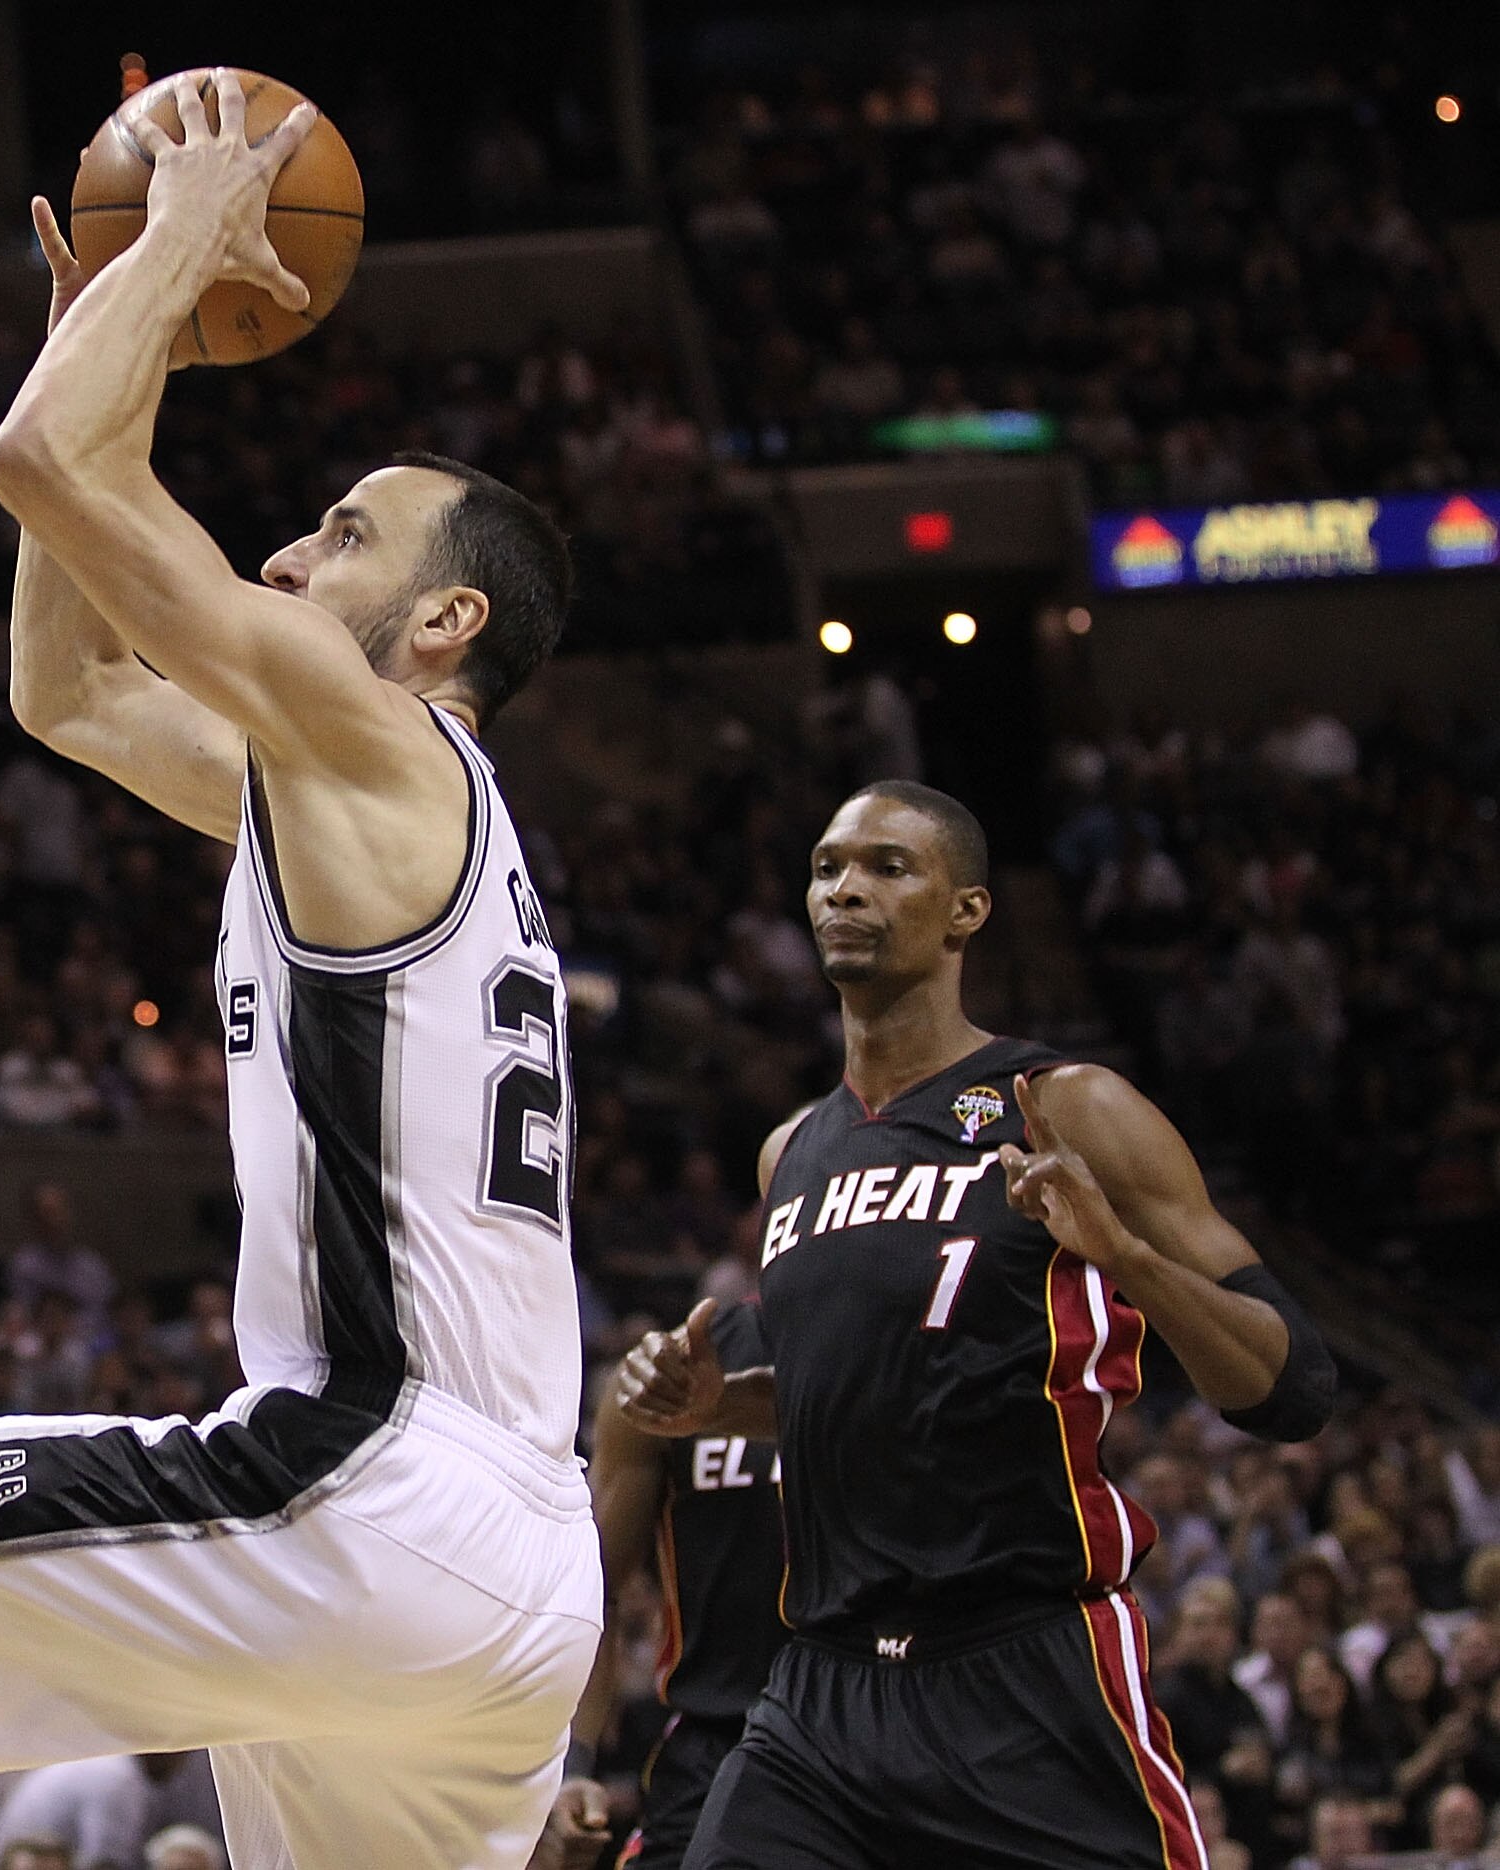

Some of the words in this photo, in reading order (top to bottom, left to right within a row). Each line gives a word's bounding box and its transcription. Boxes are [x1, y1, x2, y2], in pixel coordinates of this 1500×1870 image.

[760, 1195, 805, 1270] EL
[813, 1151, 1001, 1237] HEAT
[921, 1236, 980, 1330] 1
[691, 1434, 754, 1492] EL
